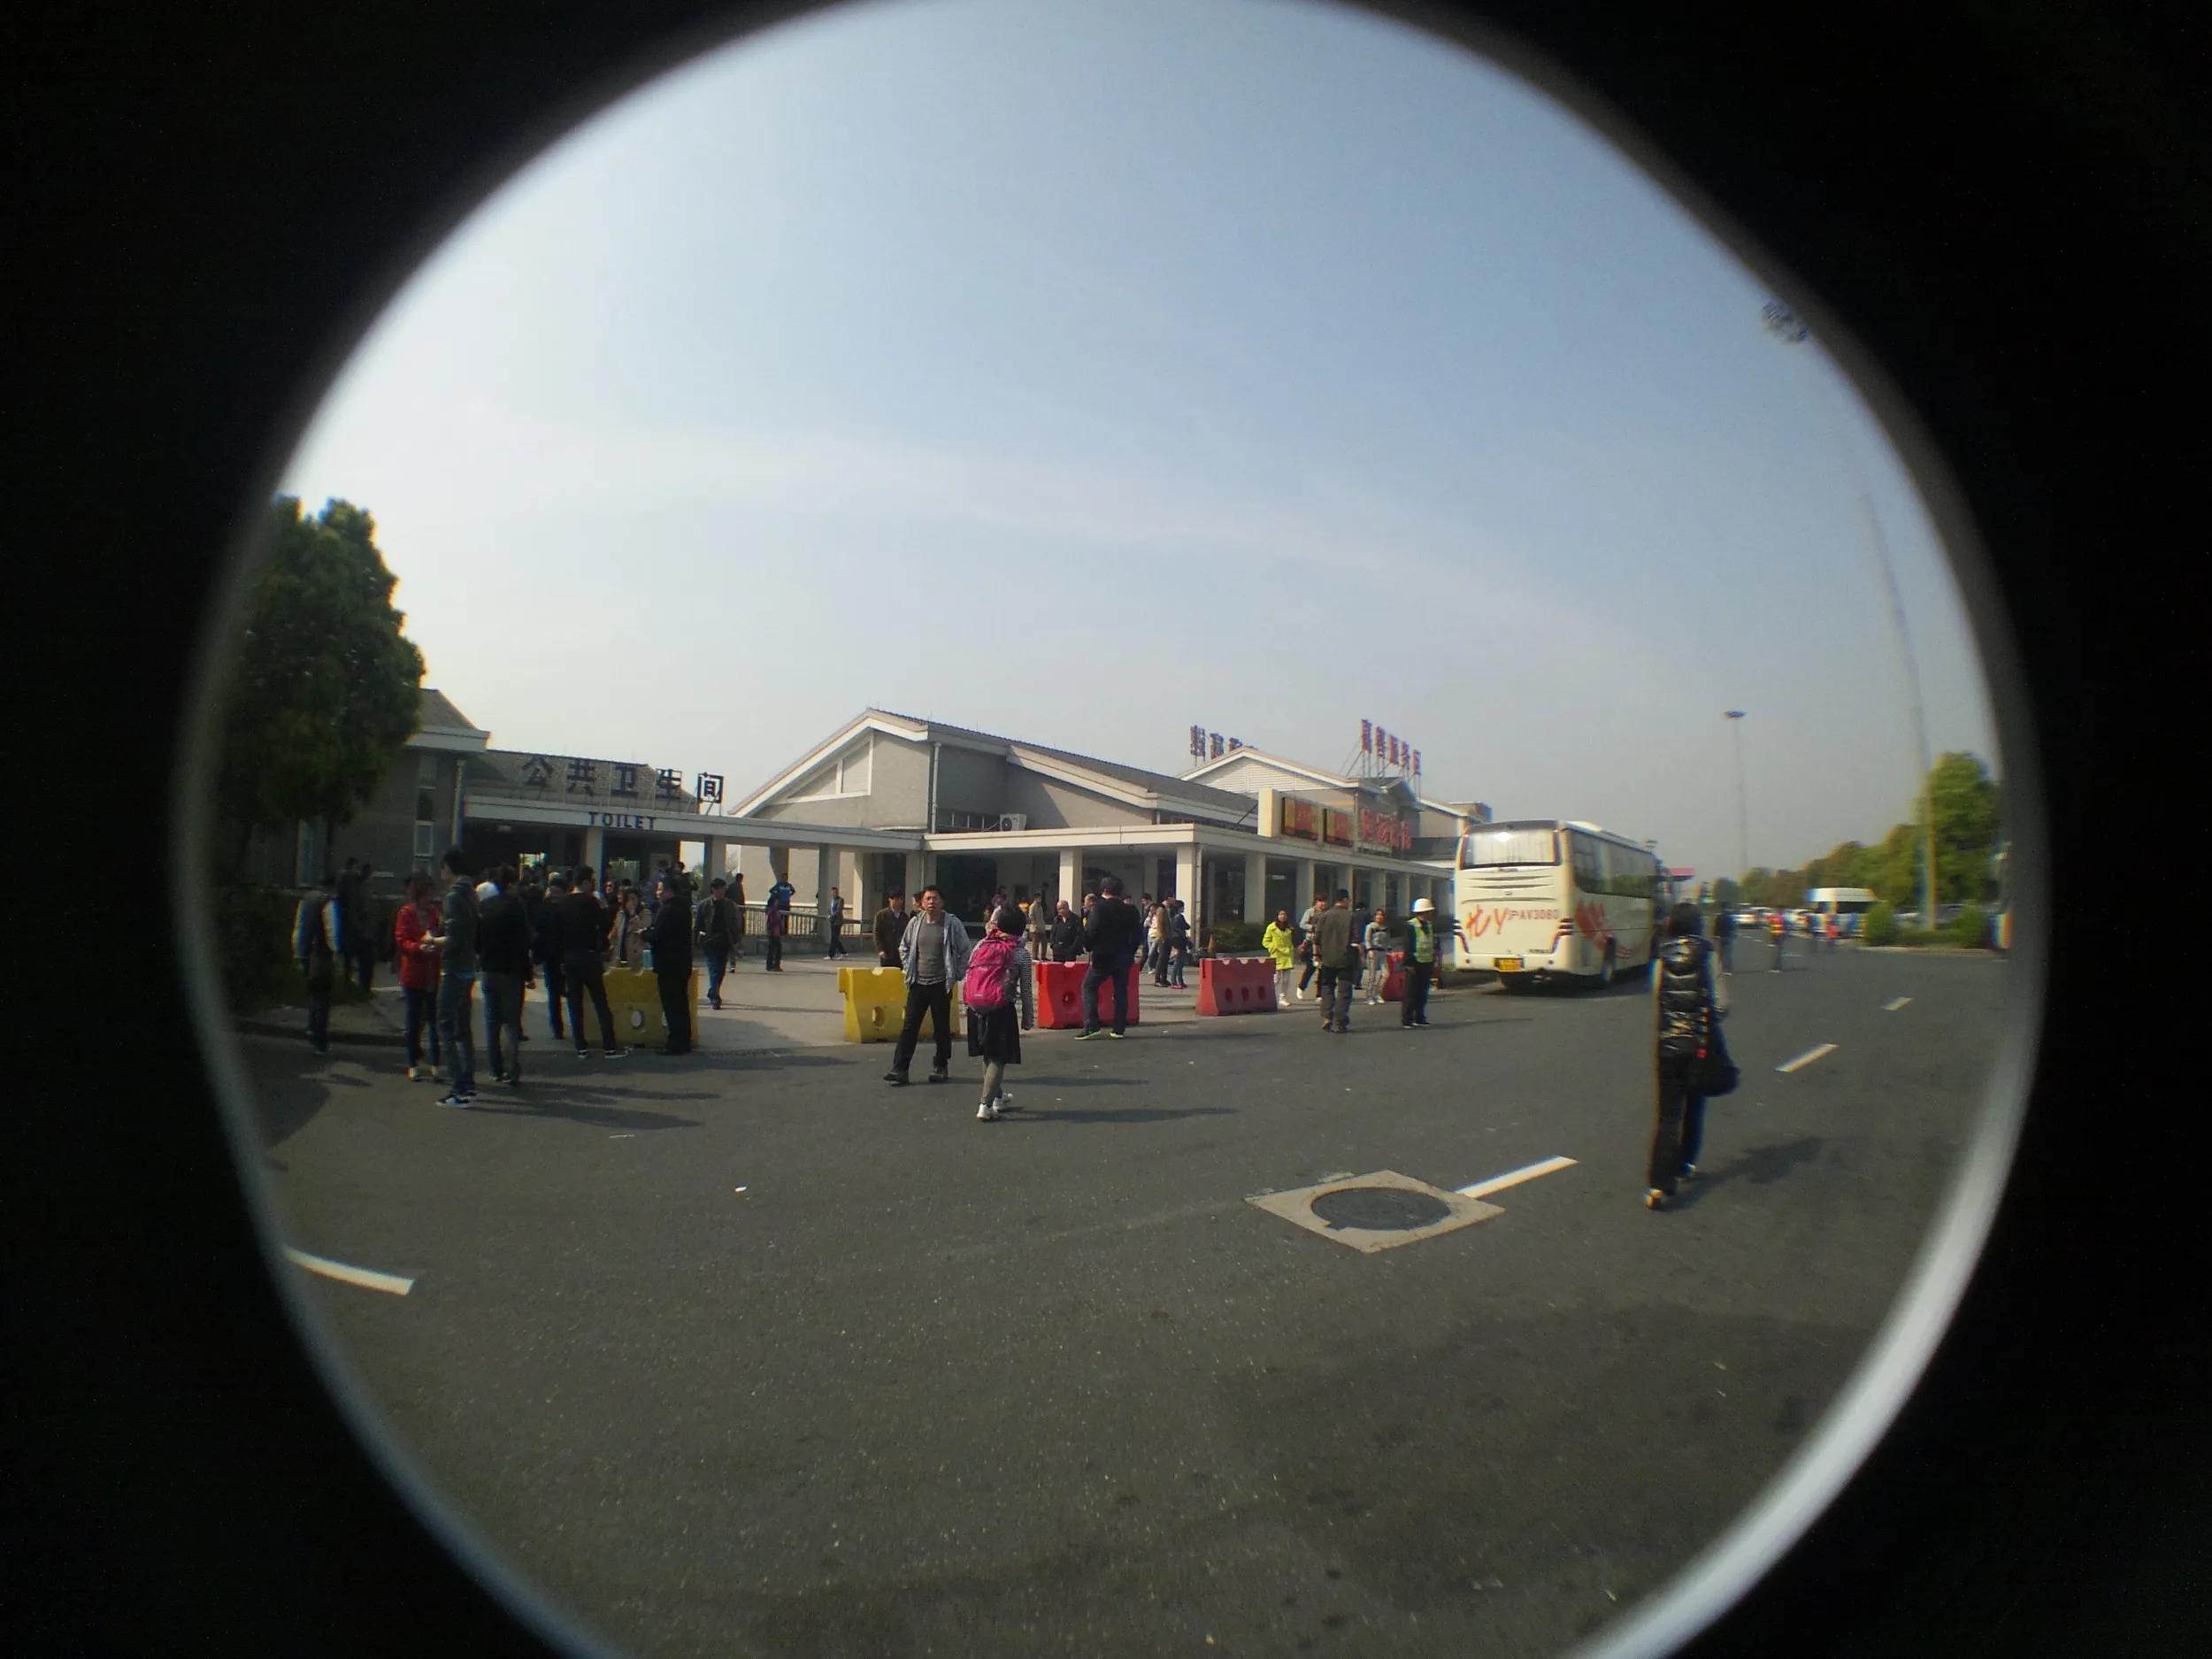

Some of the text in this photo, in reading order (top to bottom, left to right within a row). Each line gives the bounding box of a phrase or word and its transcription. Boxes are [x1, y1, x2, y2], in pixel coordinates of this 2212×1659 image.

[521, 757, 724, 804] 公共卫生间
[588, 811, 657, 830] TOILET
